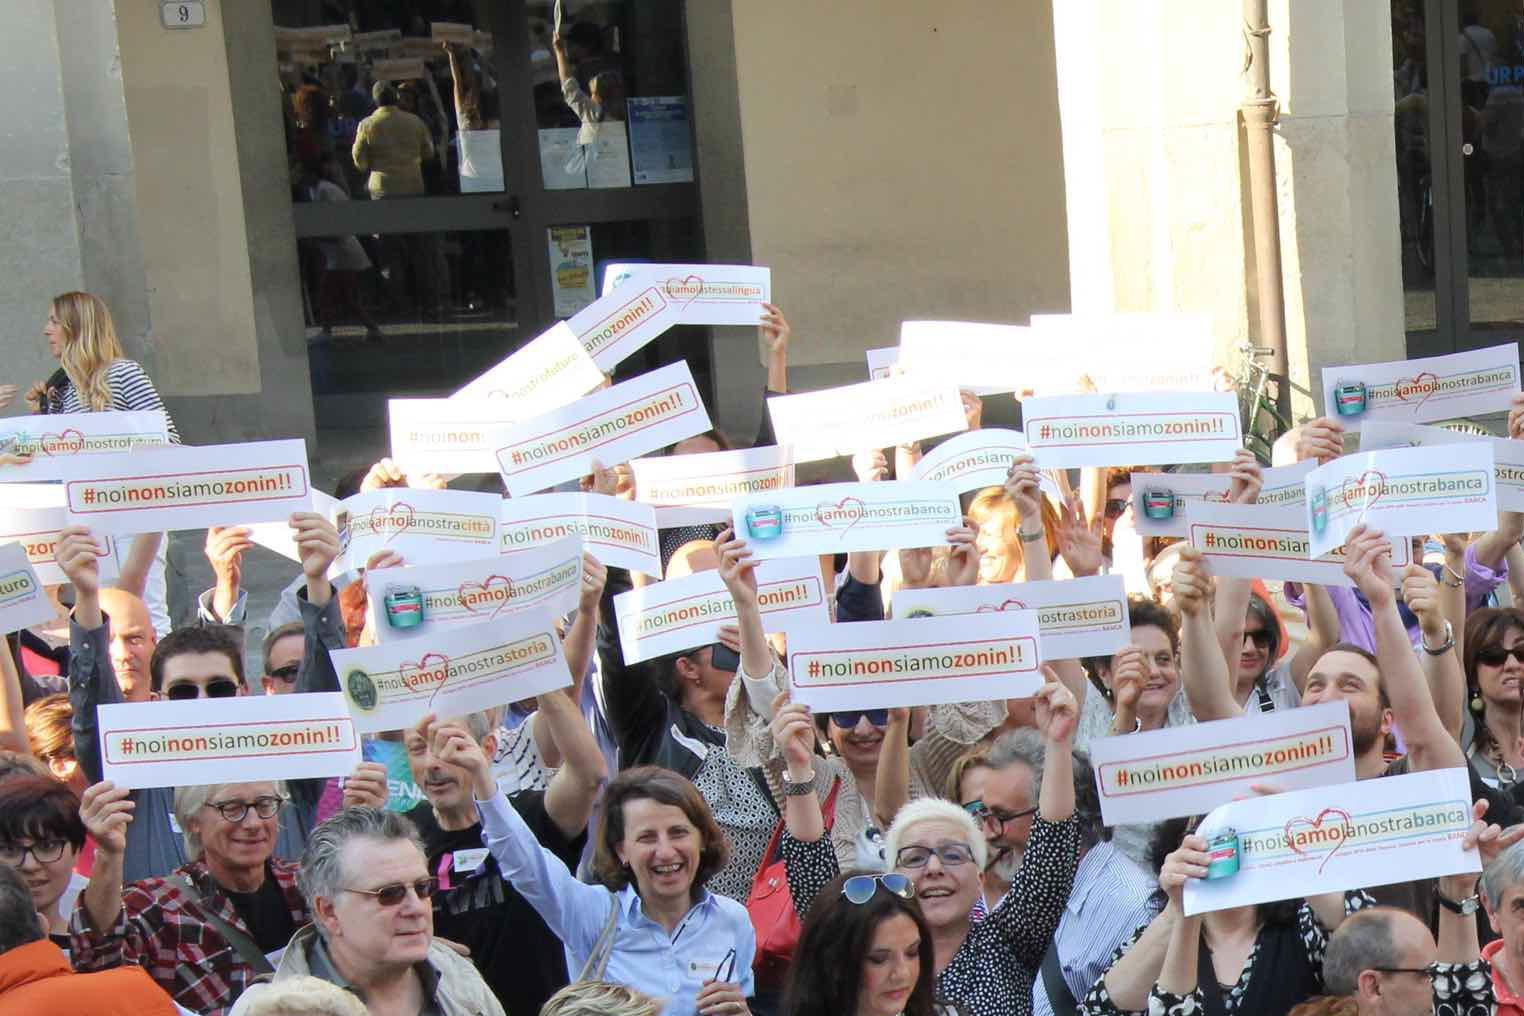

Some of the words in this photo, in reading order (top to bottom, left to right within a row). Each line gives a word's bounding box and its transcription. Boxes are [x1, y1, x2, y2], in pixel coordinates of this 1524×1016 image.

[179, 5, 189, 23] 9
[584, 297, 655, 352] amozonin!!
[511, 391, 685, 465] #noinonsiamozonin!!
[1039, 416, 1225, 441] #noinonsiamozonin!!
[83, 473, 293, 504] #noinonsiamozonin!!
[807, 646, 1023, 678] #noinonsiamozonin!!
[120, 725, 341, 755] #noinonsiamozonin!!
[1114, 735, 1334, 788] #noinonsiamozonin!!
